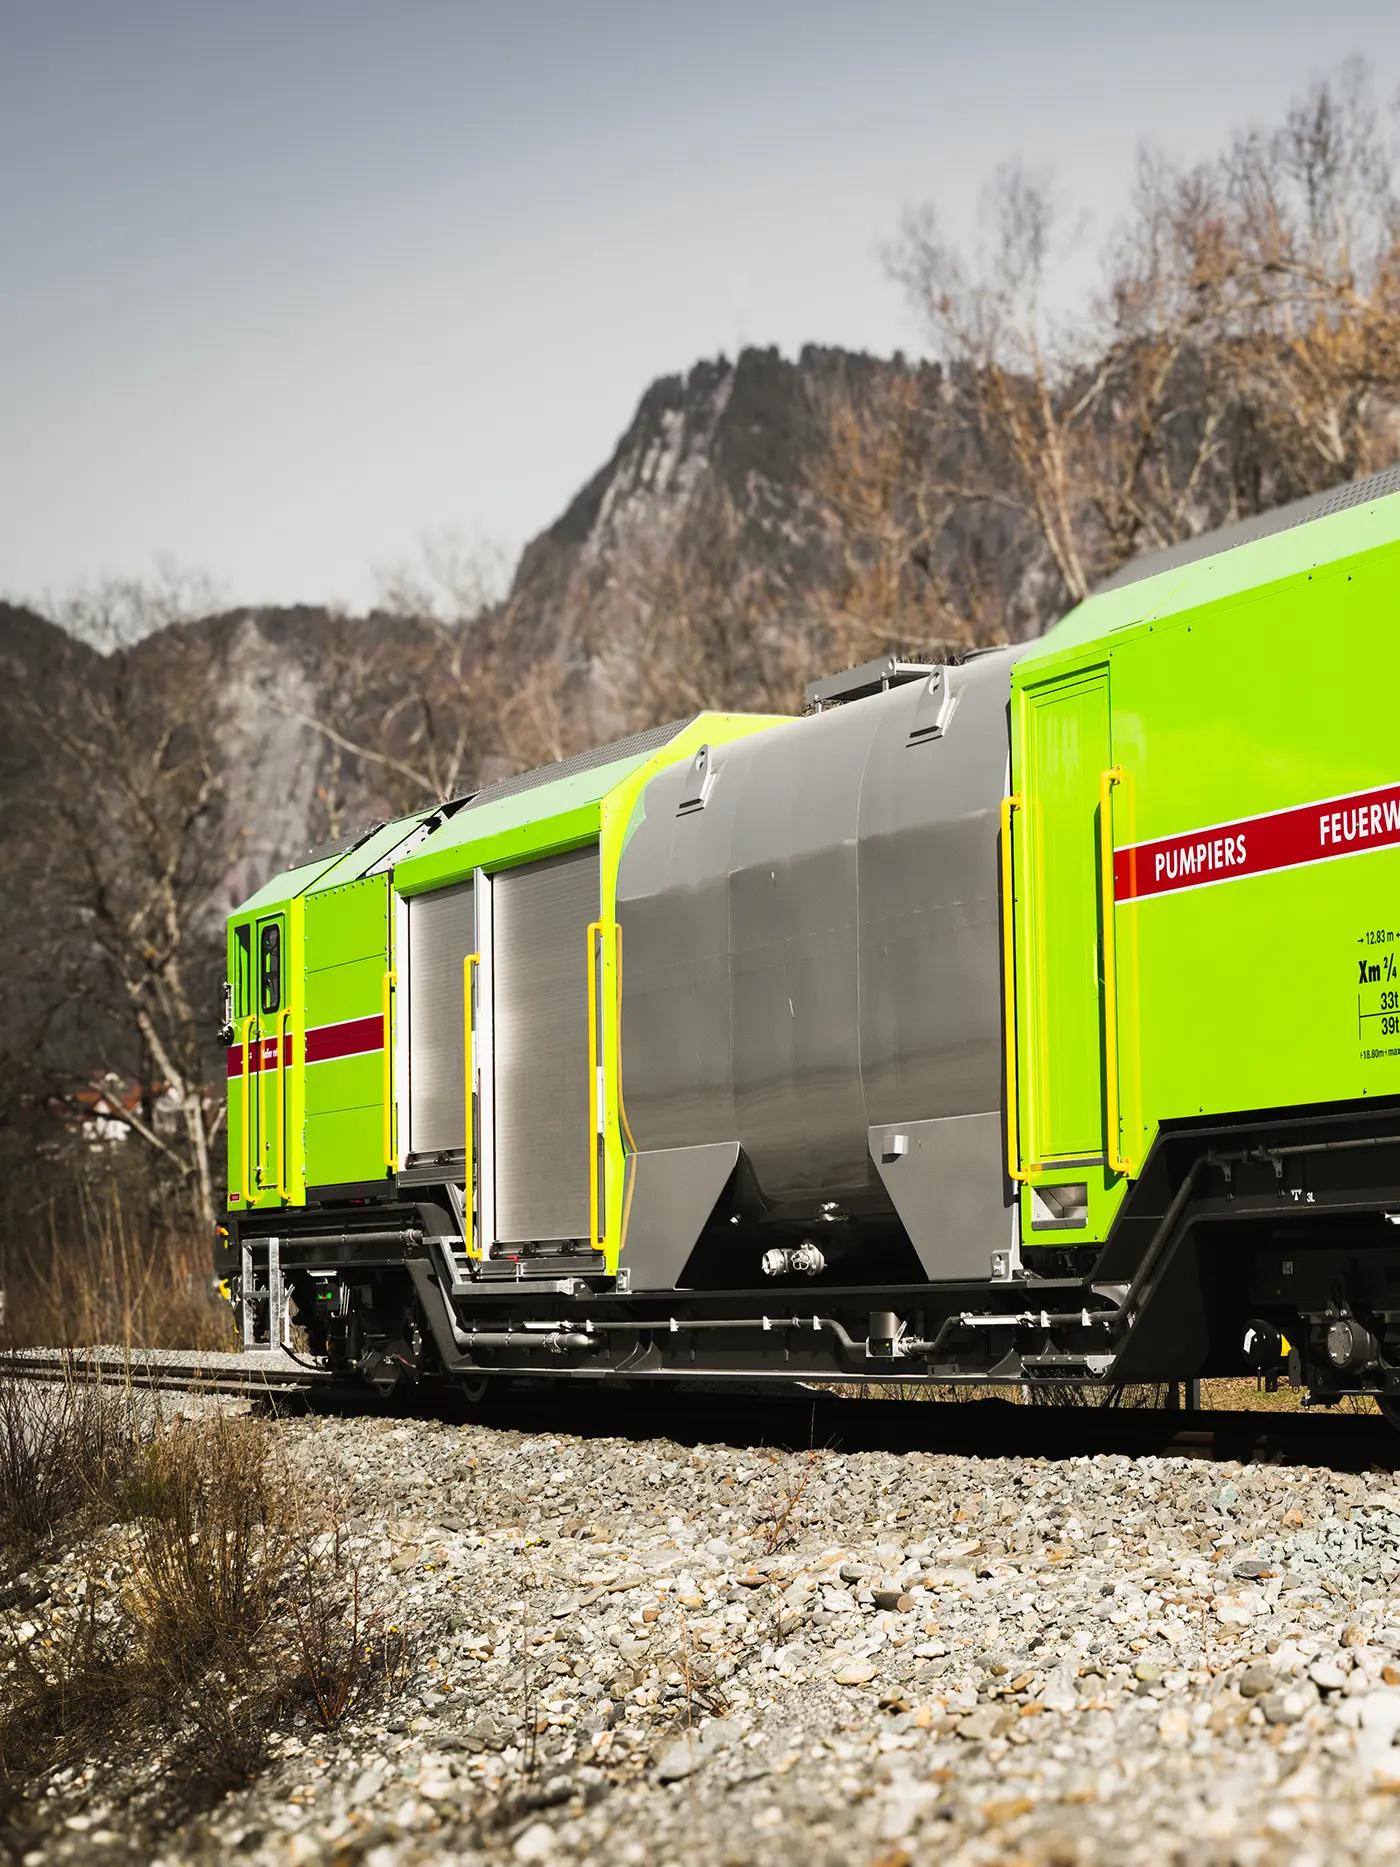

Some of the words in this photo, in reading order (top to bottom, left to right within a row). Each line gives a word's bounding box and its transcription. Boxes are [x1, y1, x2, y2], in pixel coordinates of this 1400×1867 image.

[1155, 834, 1247, 882] PUMPIERS
[1358, 959, 1381, 984] Xm
[1380, 991, 1399, 1010] 33t
[1381, 1016, 1400, 1036] 39t
[1306, 1191, 1316, 1203] 3L
